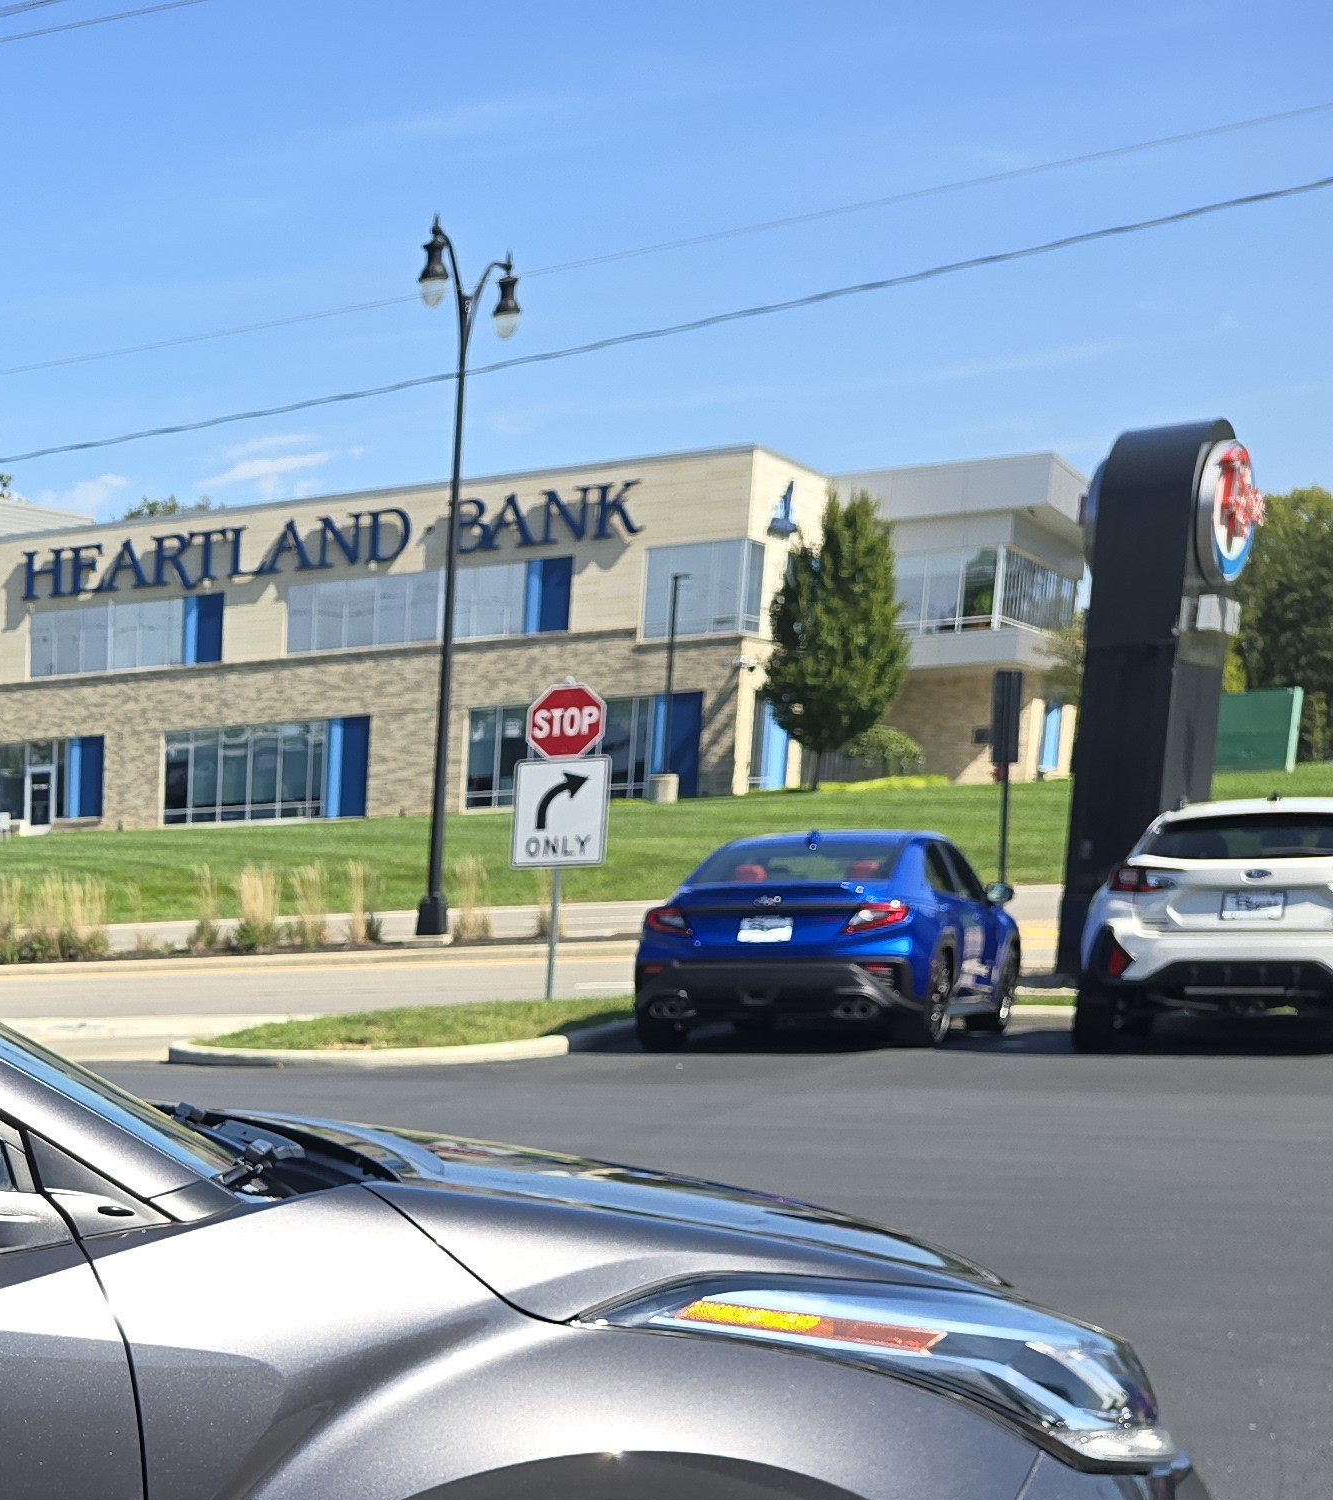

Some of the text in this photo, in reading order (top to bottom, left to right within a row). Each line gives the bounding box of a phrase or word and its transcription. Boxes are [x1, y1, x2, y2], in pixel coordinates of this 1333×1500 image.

[23, 478, 646, 601] HEARTLAND BANK
[533, 705, 600, 739] STOP
[525, 833, 592, 858] ONLY
